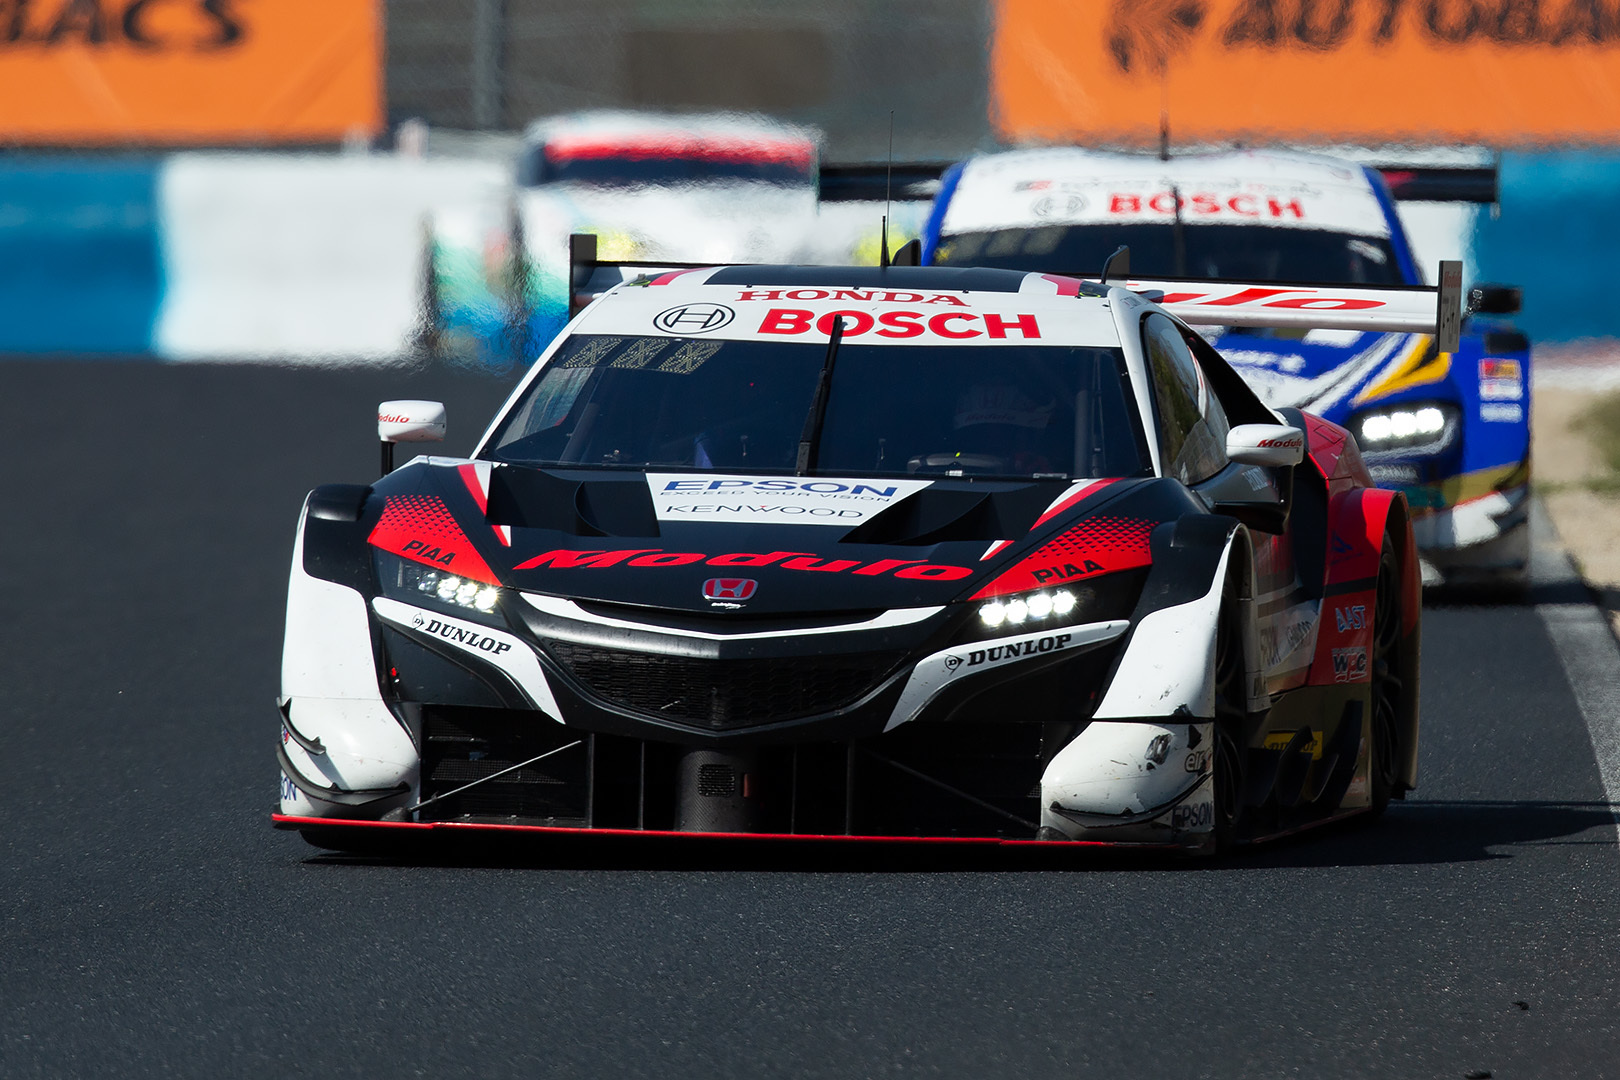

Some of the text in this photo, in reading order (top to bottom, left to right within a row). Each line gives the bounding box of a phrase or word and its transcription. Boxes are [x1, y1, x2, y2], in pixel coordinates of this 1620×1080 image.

[1109, 193, 1306, 219] BOSCH
[735, 289, 971, 307] HONDA
[758, 308, 1041, 339] BOSCH
[663, 480, 898, 497] EPSON
[820, 494, 891, 503] VISION
[665, 504, 864, 519] KENWOOD
[402, 539, 456, 567] PIAA
[513, 549, 974, 581] Modulo
[1031, 558, 1105, 584] PIAA
[424, 618, 512, 656] DUNLOP
[967, 633, 1072, 667] DUNLOP
[1172, 801, 1213, 828] EPSON
